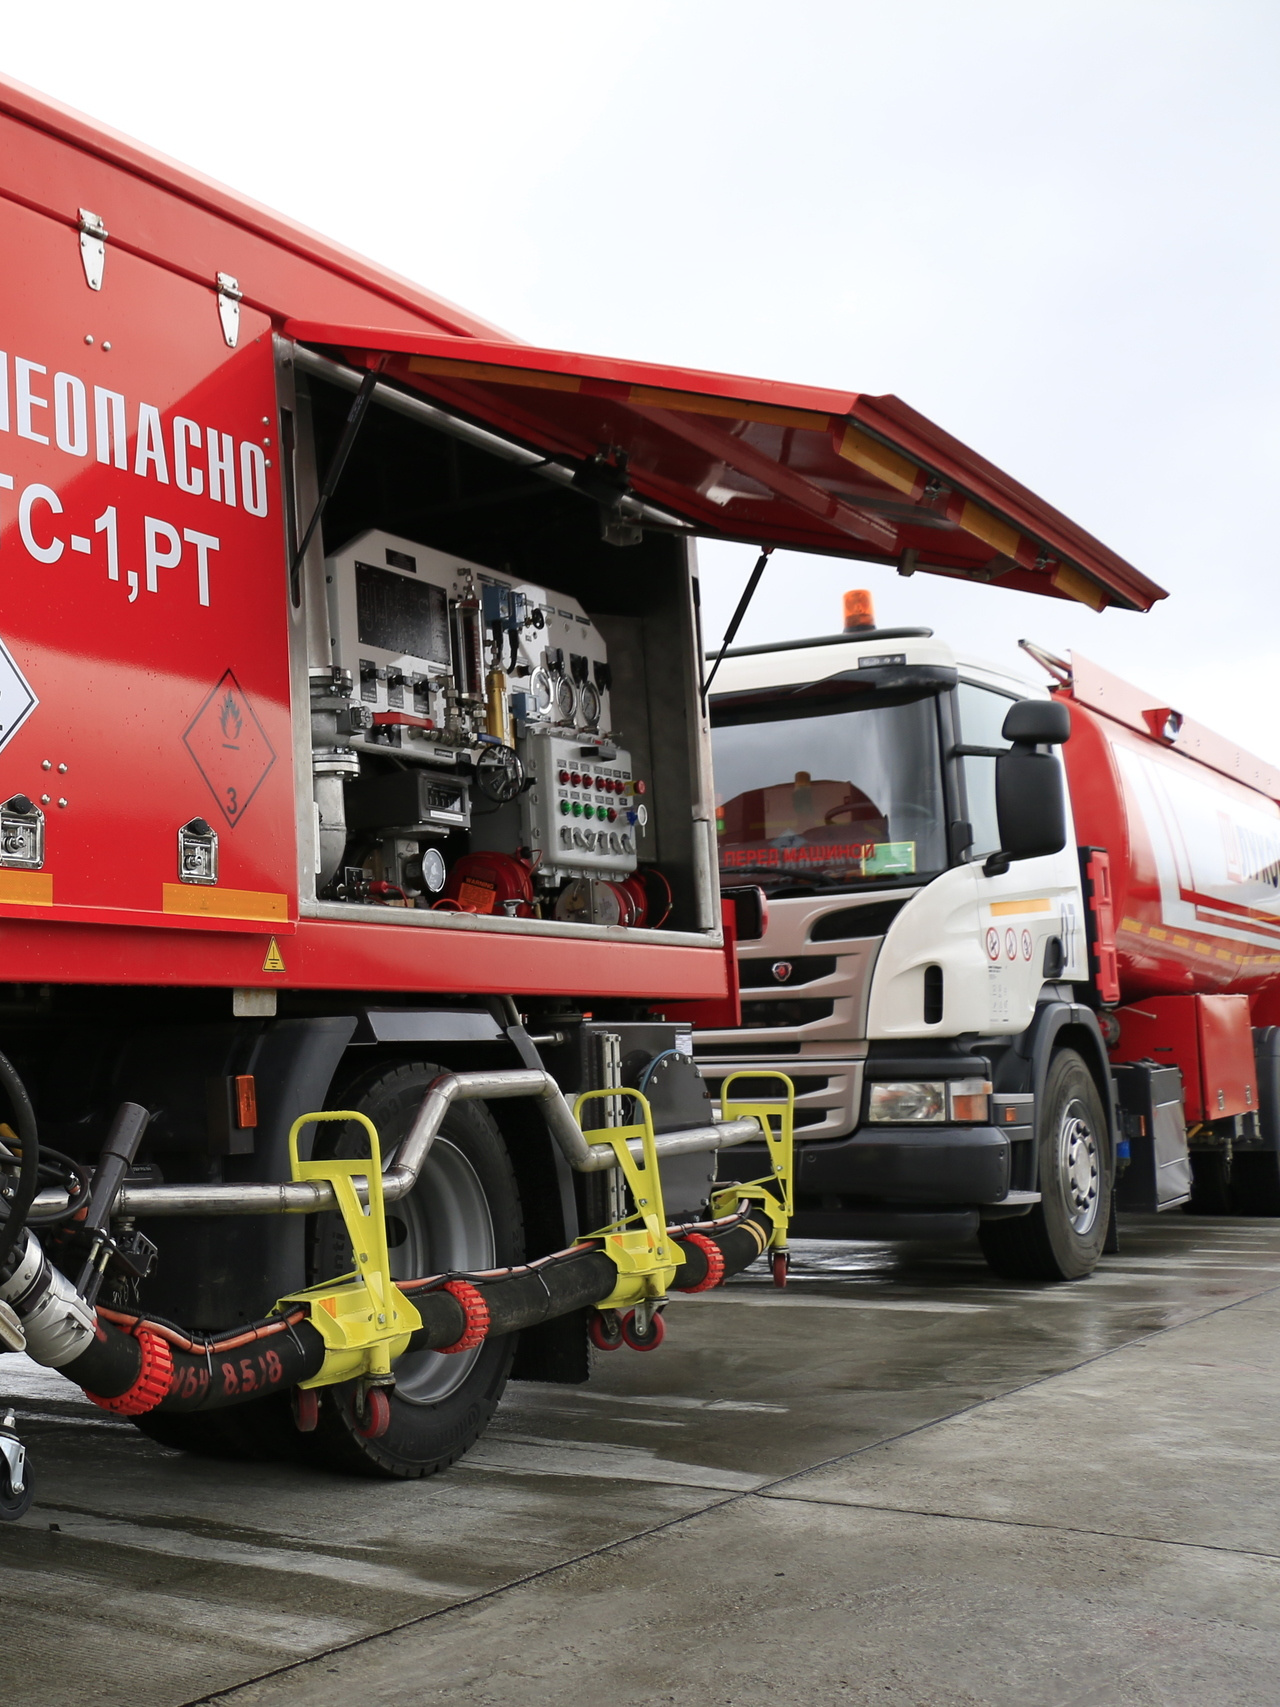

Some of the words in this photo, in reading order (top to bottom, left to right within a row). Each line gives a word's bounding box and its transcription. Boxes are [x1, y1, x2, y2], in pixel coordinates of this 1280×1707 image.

[226, 786, 238, 815] 3
[724, 848, 779, 867] ПЕРЕД
[783, 840, 877, 863] МАШИНОЙ
[466, 877, 495, 890] WARNING
